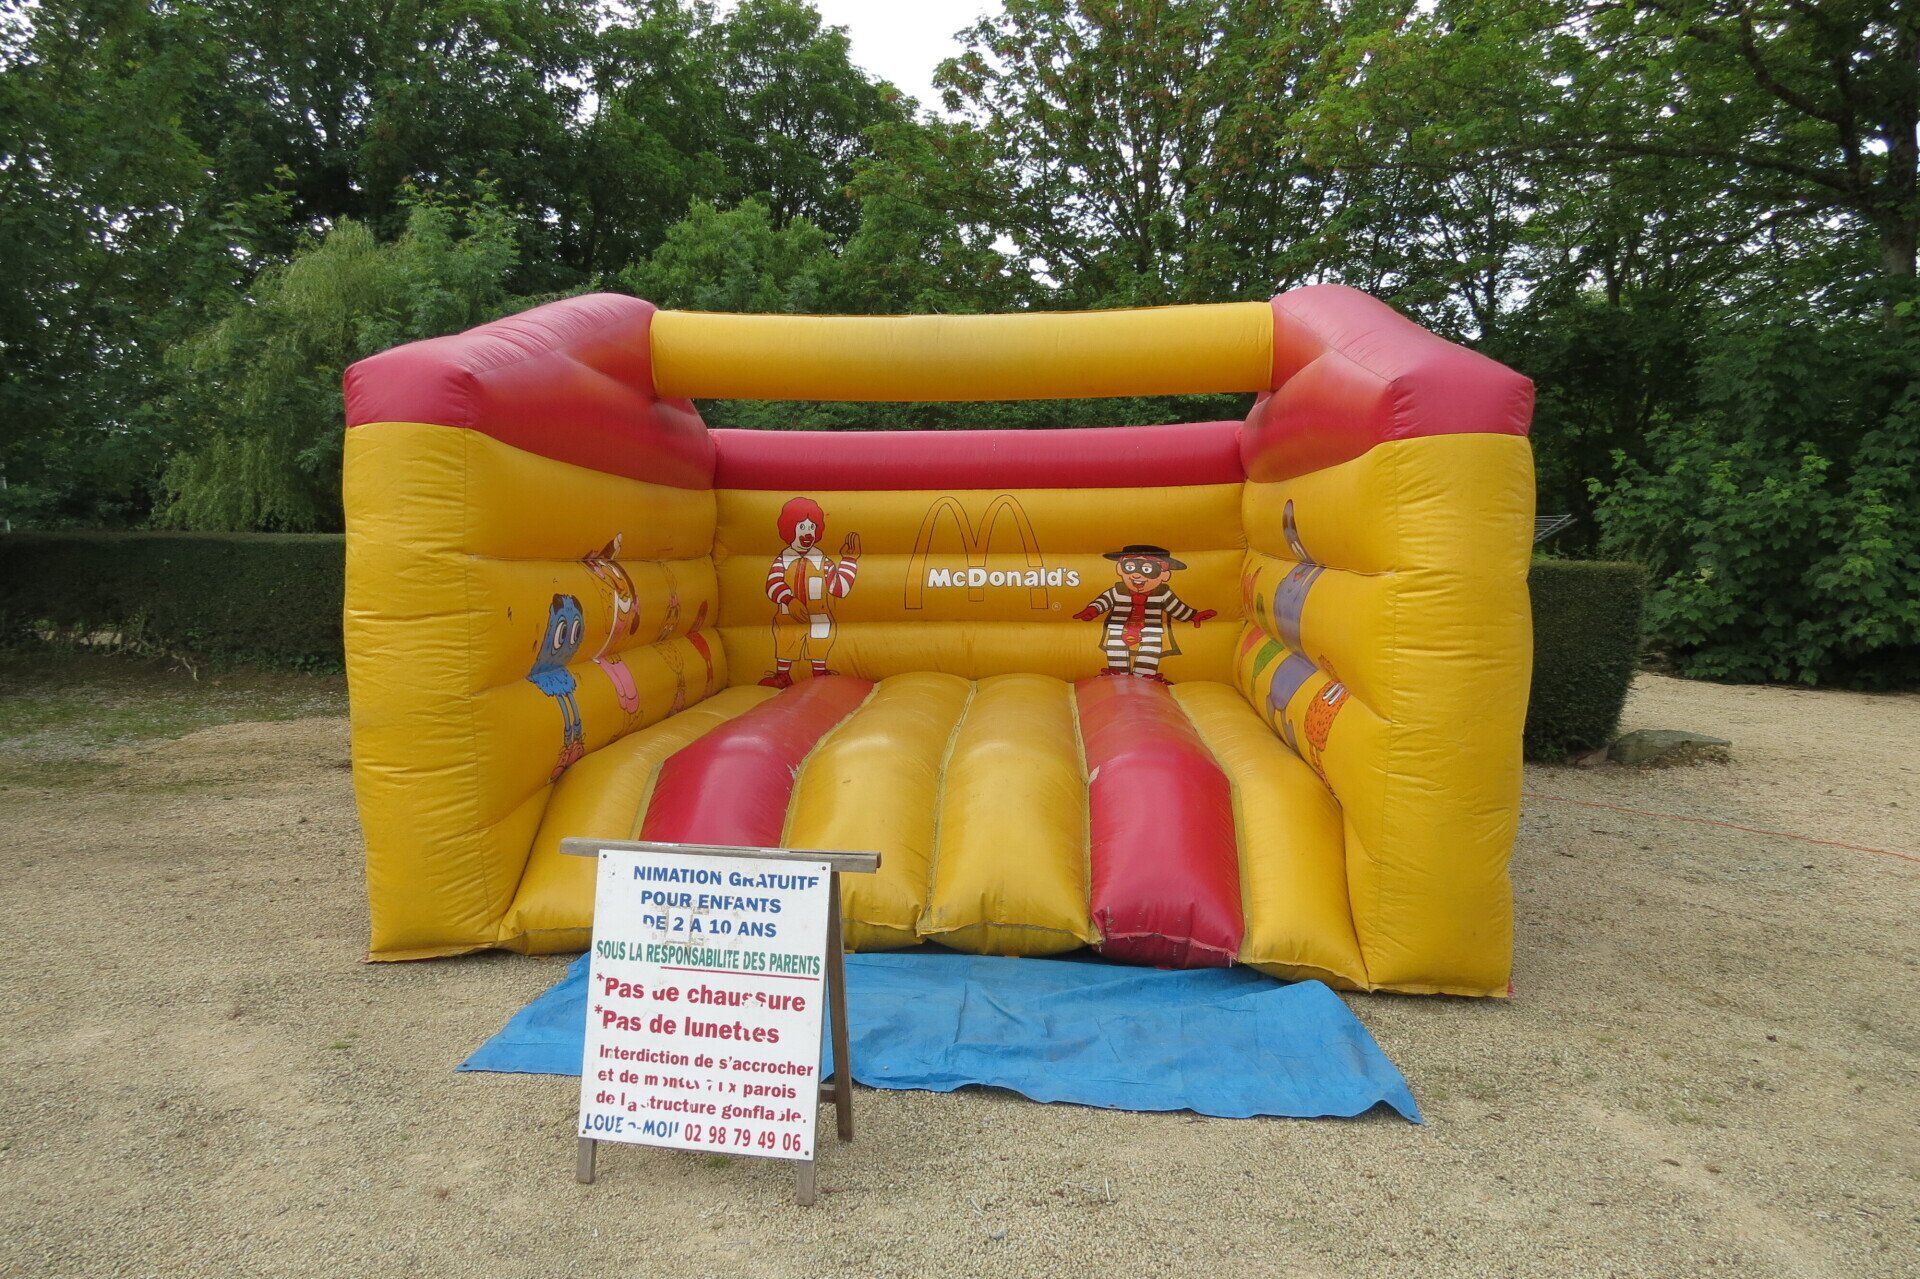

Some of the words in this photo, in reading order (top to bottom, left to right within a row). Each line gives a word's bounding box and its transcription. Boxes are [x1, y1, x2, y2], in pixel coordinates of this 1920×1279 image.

[927, 567, 1080, 588] McDonald's
[640, 890, 691, 908] POUR
[698, 894, 782, 914] ENFANTS
[643, 914, 666, 931] DE
[673, 916, 684, 931] 2
[690, 918, 702, 933] A
[710, 919, 731, 935] 10
[737, 922, 777, 938] ANS
[596, 940, 626, 961] SOUS
[629, 943, 643, 962] LA
[646, 945, 739, 969] RESPONSABILITE
[743, 951, 766, 971] DES
[769, 953, 820, 976] PARENTS
[649, 1014, 676, 1035] de
[600, 1045, 688, 1066] Interdiction
[694, 1053, 713, 1068] de
[719, 1056, 813, 1077] s'accrocher
[598, 1068, 613, 1082] et
[620, 1070, 639, 1084] de
[743, 1082, 797, 1099] parois
[596, 1090, 615, 1105] de
[684, 1123, 701, 1142] 02
[709, 1126, 727, 1145] 98
[733, 1128, 751, 1147] 79
[757, 1130, 776, 1150] 49
[782, 1132, 801, 1152] 06
